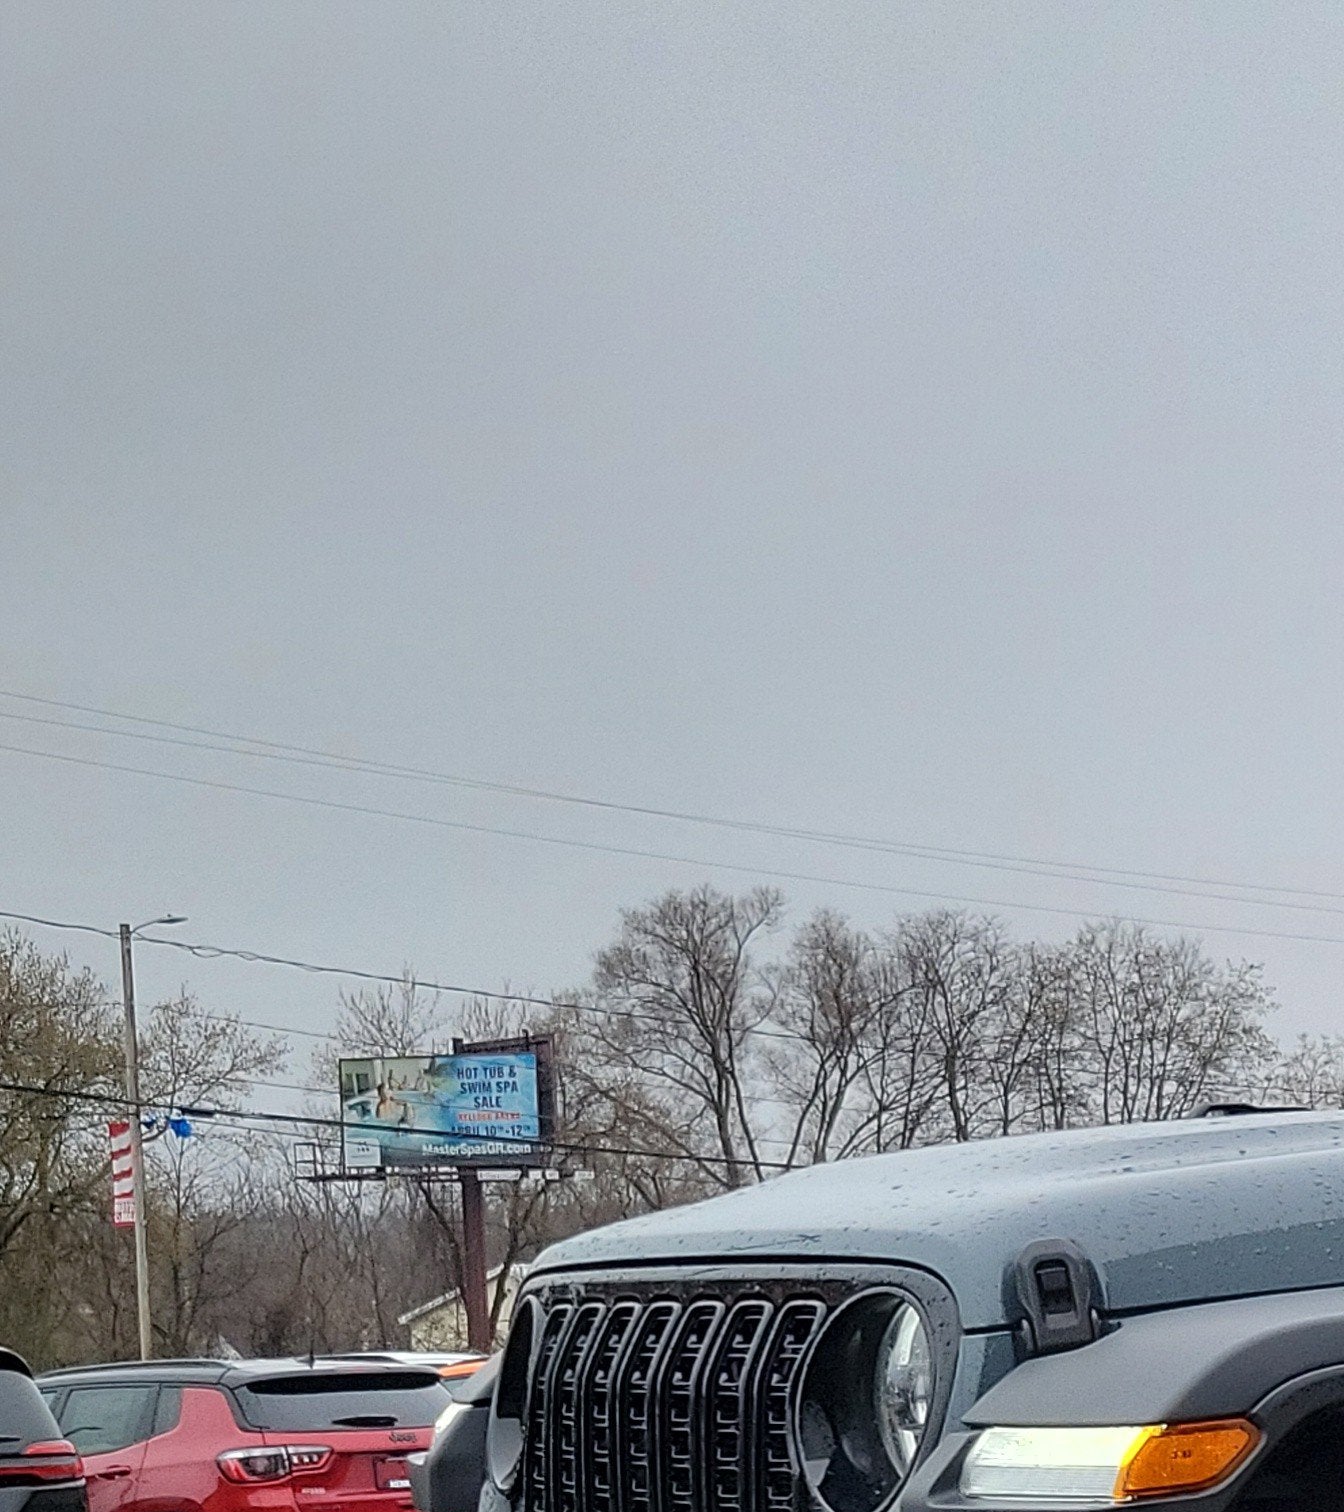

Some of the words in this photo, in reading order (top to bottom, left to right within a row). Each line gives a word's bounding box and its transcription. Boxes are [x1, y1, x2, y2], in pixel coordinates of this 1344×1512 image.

[457, 1067, 478, 1080] HOT
[483, 1066, 505, 1079] TUB
[508, 1065, 517, 1078] &
[460, 1081, 493, 1094] SWIM
[496, 1080, 518, 1093] SPA
[474, 1096, 502, 1108] SALE
